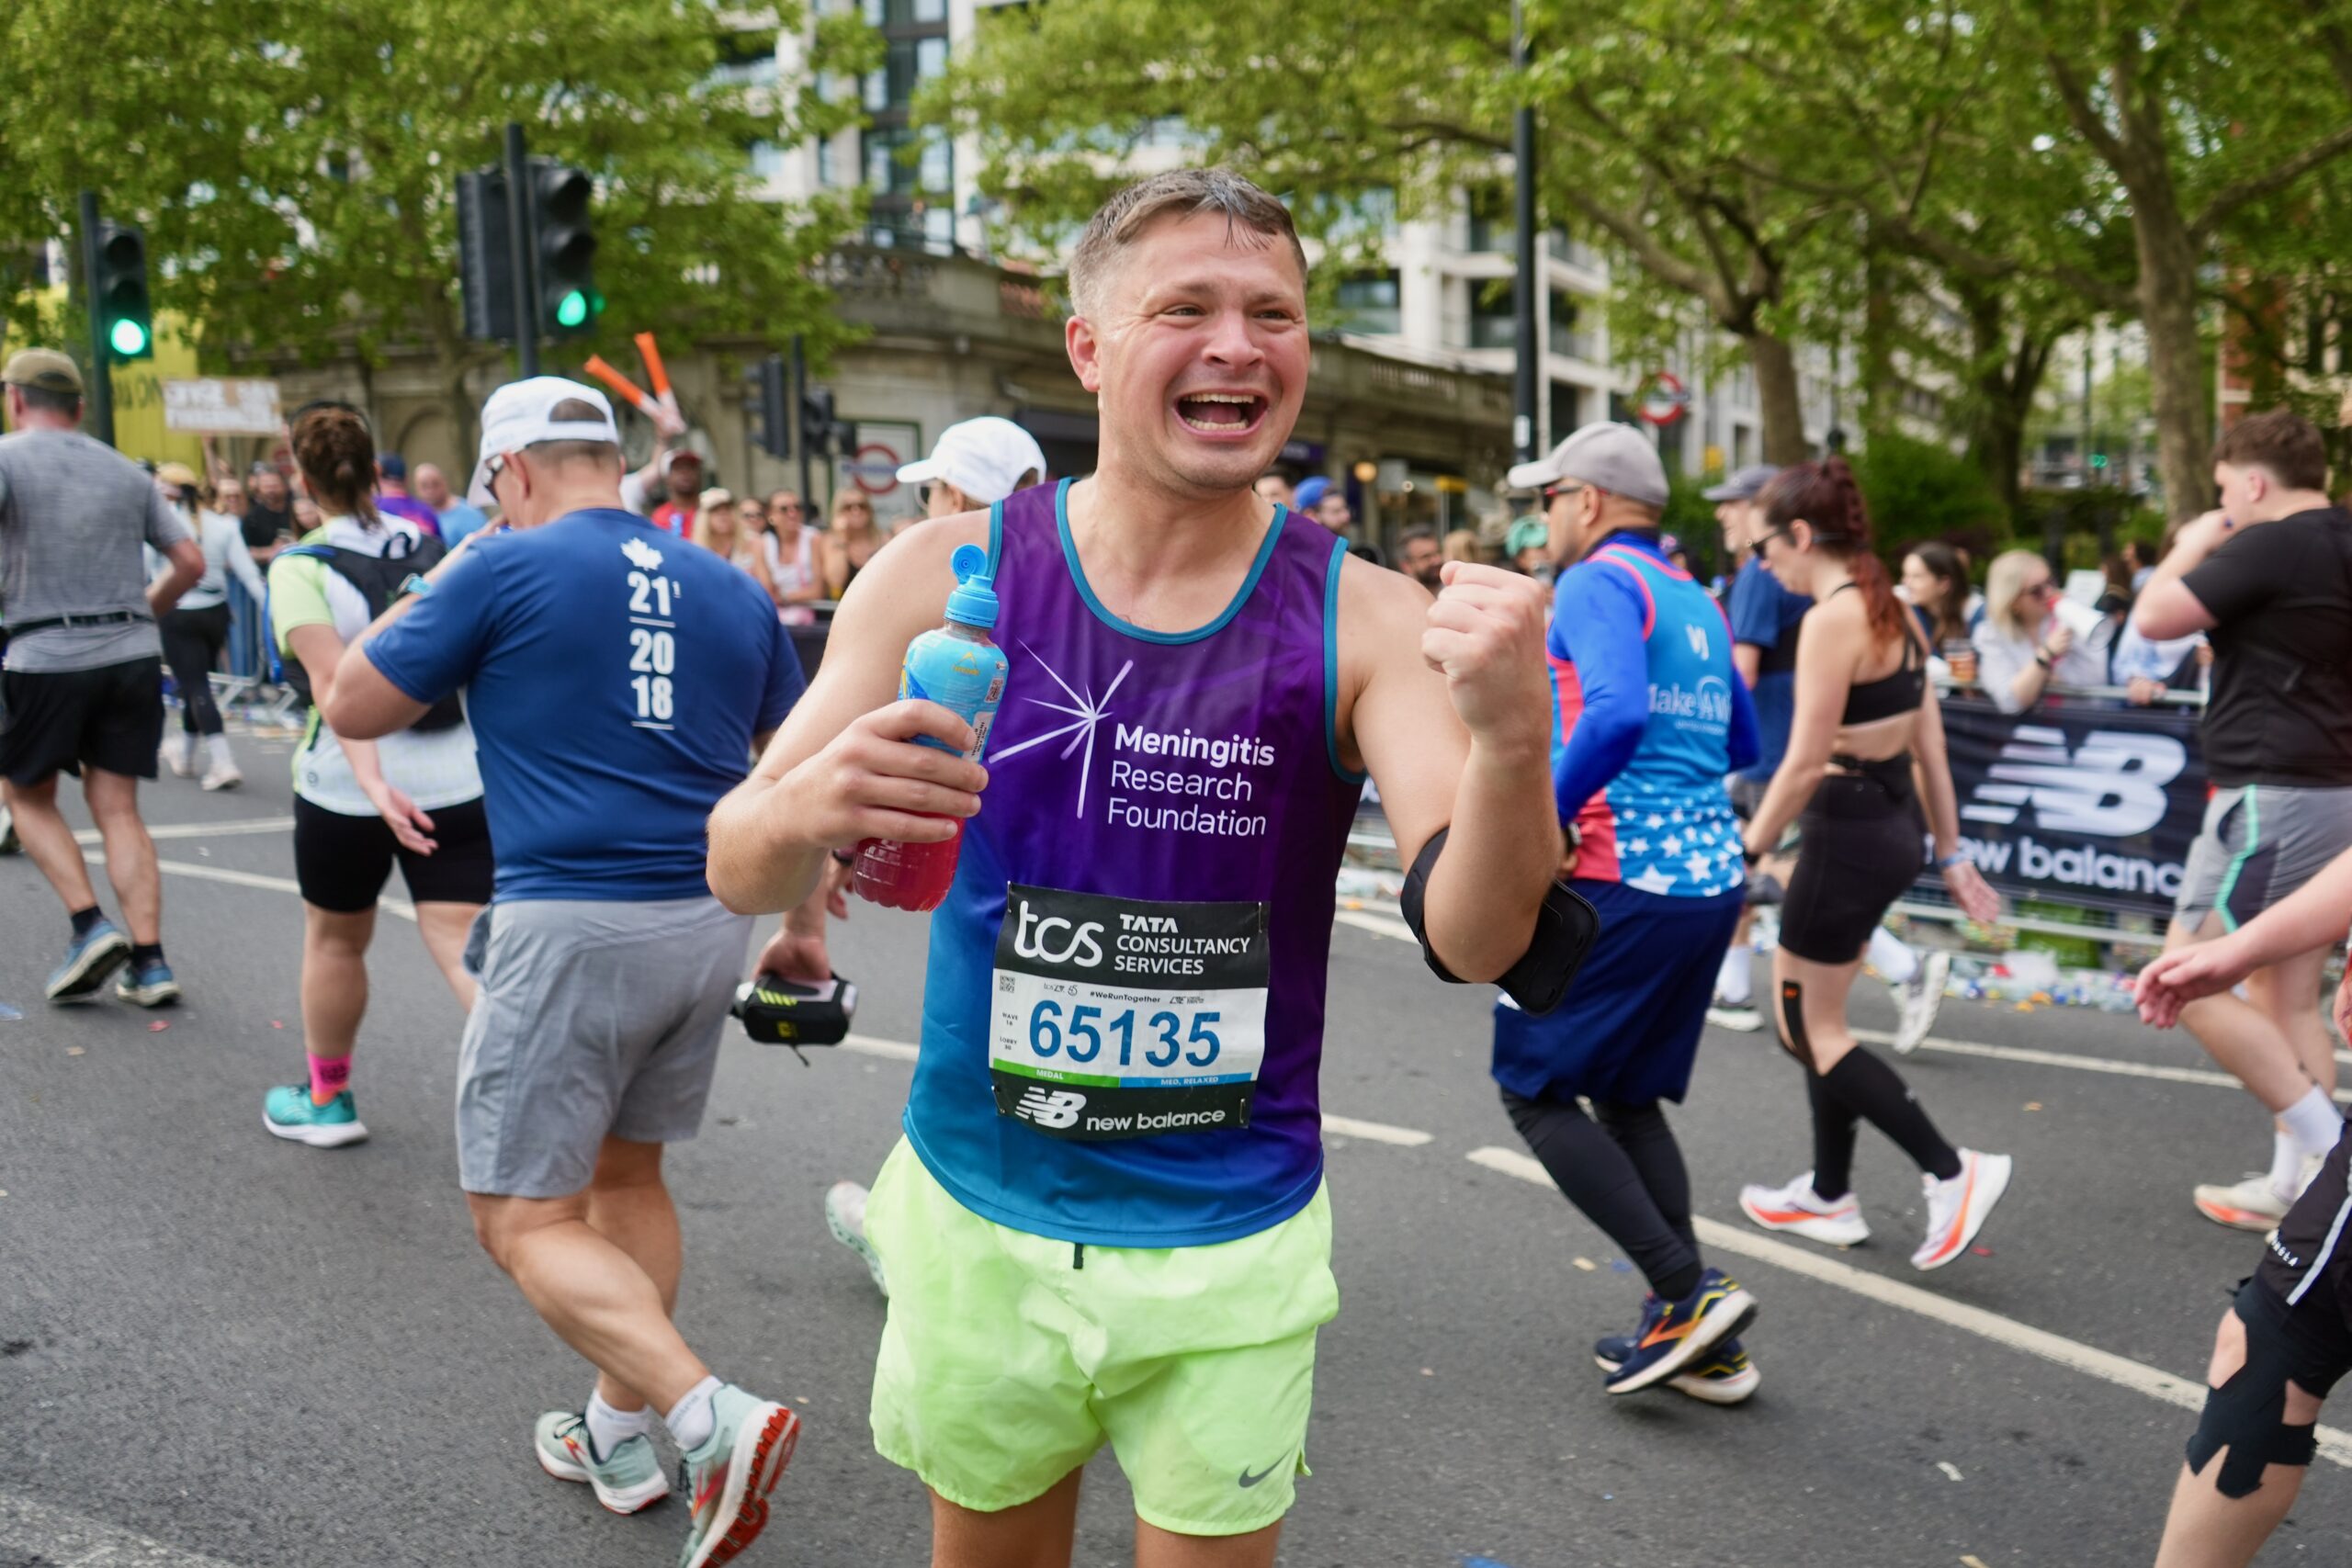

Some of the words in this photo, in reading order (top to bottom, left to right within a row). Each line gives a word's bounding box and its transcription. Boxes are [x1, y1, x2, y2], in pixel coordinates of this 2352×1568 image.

[629, 627, 675, 675] 20
[630, 674, 673, 720] 18
[1114, 723, 1275, 768] Meningitis
[1111, 760, 1252, 801] Research
[1108, 796, 1267, 836] Foundation
[2018, 835, 2186, 897] balanc
[1014, 900, 1104, 967] tcs
[1119, 913, 1179, 933] TATA
[1116, 934, 1250, 954] CONSULTANCY
[1114, 954, 1204, 975] SERVICES
[1090, 991, 1161, 1003] #WeRunTogether
[1029, 998, 1220, 1067] 65135
[1035, 1068, 1064, 1080] MEDAL
[1182, 1076, 1219, 1085] RELAXED
[1086, 1115, 1133, 1132] new
[1136, 1110, 1226, 1130] balance
